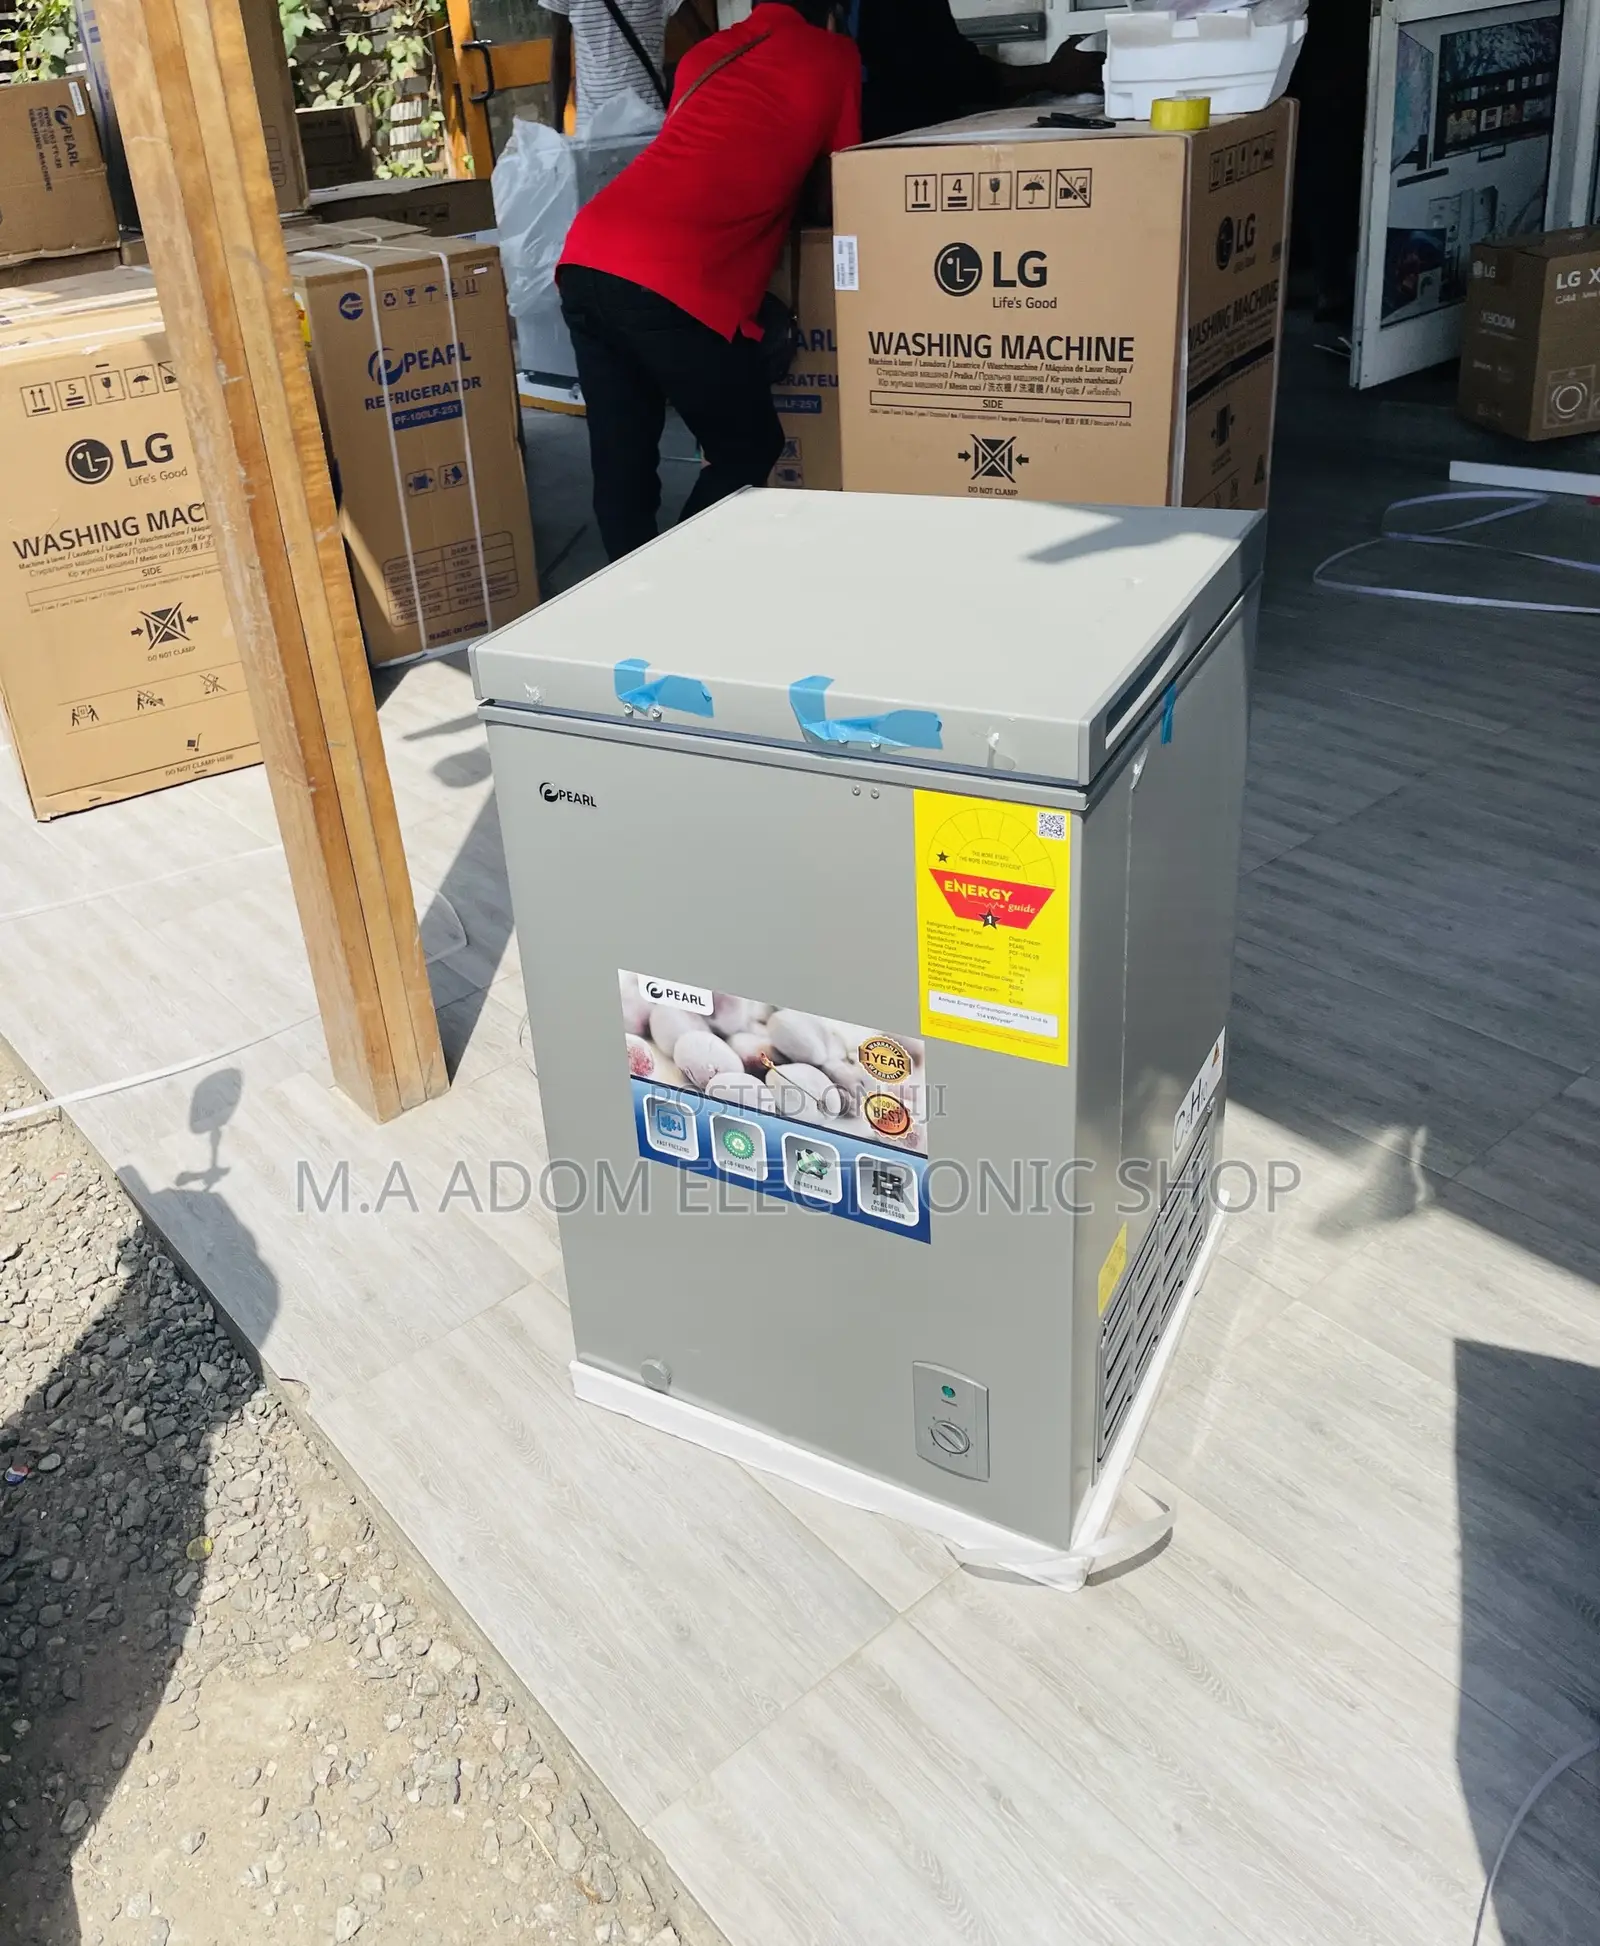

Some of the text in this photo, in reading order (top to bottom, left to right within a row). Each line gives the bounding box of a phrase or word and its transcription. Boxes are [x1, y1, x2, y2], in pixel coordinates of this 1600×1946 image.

[62, 126, 80, 167] PEARL
[952, 178, 963, 194] 4
[1236, 213, 1256, 253] LG
[992, 251, 1048, 288] LG
[1556, 271, 1581, 290] LG
[992, 297, 1057, 309] Life's Good
[1234, 279, 1279, 322] MACHINE
[868, 331, 1135, 362] WASHING MACHINE
[68, 384, 77, 395] 5
[982, 400, 1003, 409] SIDE
[120, 433, 174, 469] LG
[129, 466, 188, 487] Life's Good
[995, 488, 1018, 496] CLAMP
[13, 516, 140, 560] WASHING
[141, 566, 162, 577] SIDE
[147, 646, 196, 662] DO NOT CLAMP
[559, 789, 597, 807] PEARL
[1008, 902, 1036, 914] guide
[666, 988, 705, 1007] PEARL
[868, 1041, 902, 1057] WARRANTY
[871, 1053, 905, 1070] YEAR
[873, 1107, 902, 1124] BEST
